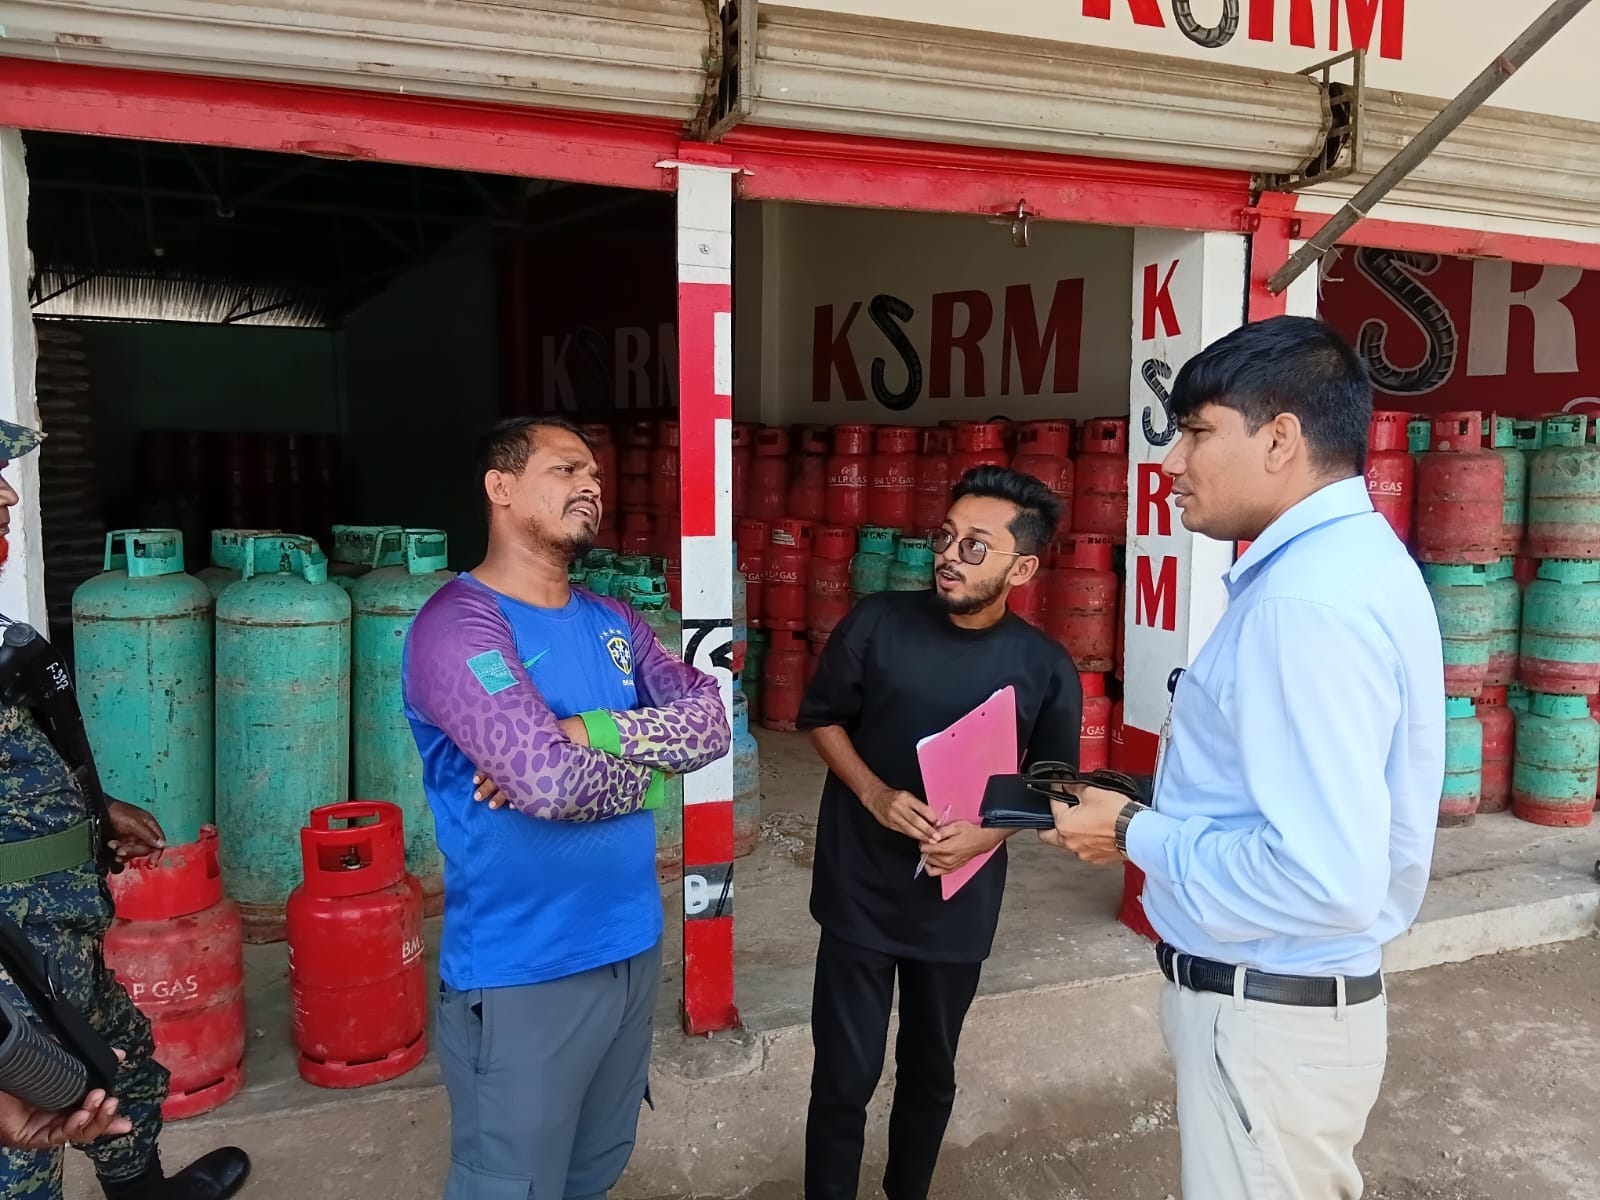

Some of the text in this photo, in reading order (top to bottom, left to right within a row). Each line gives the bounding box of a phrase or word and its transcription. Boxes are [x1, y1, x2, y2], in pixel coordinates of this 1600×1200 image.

[812, 278, 1085, 410] KSRM
[1380, 481, 1403, 492] GAS
[779, 571, 797, 580] GAS
[1087, 725, 1105, 736] GAS
[402, 936, 420, 958] BM
[152, 975, 199, 998] GAS
